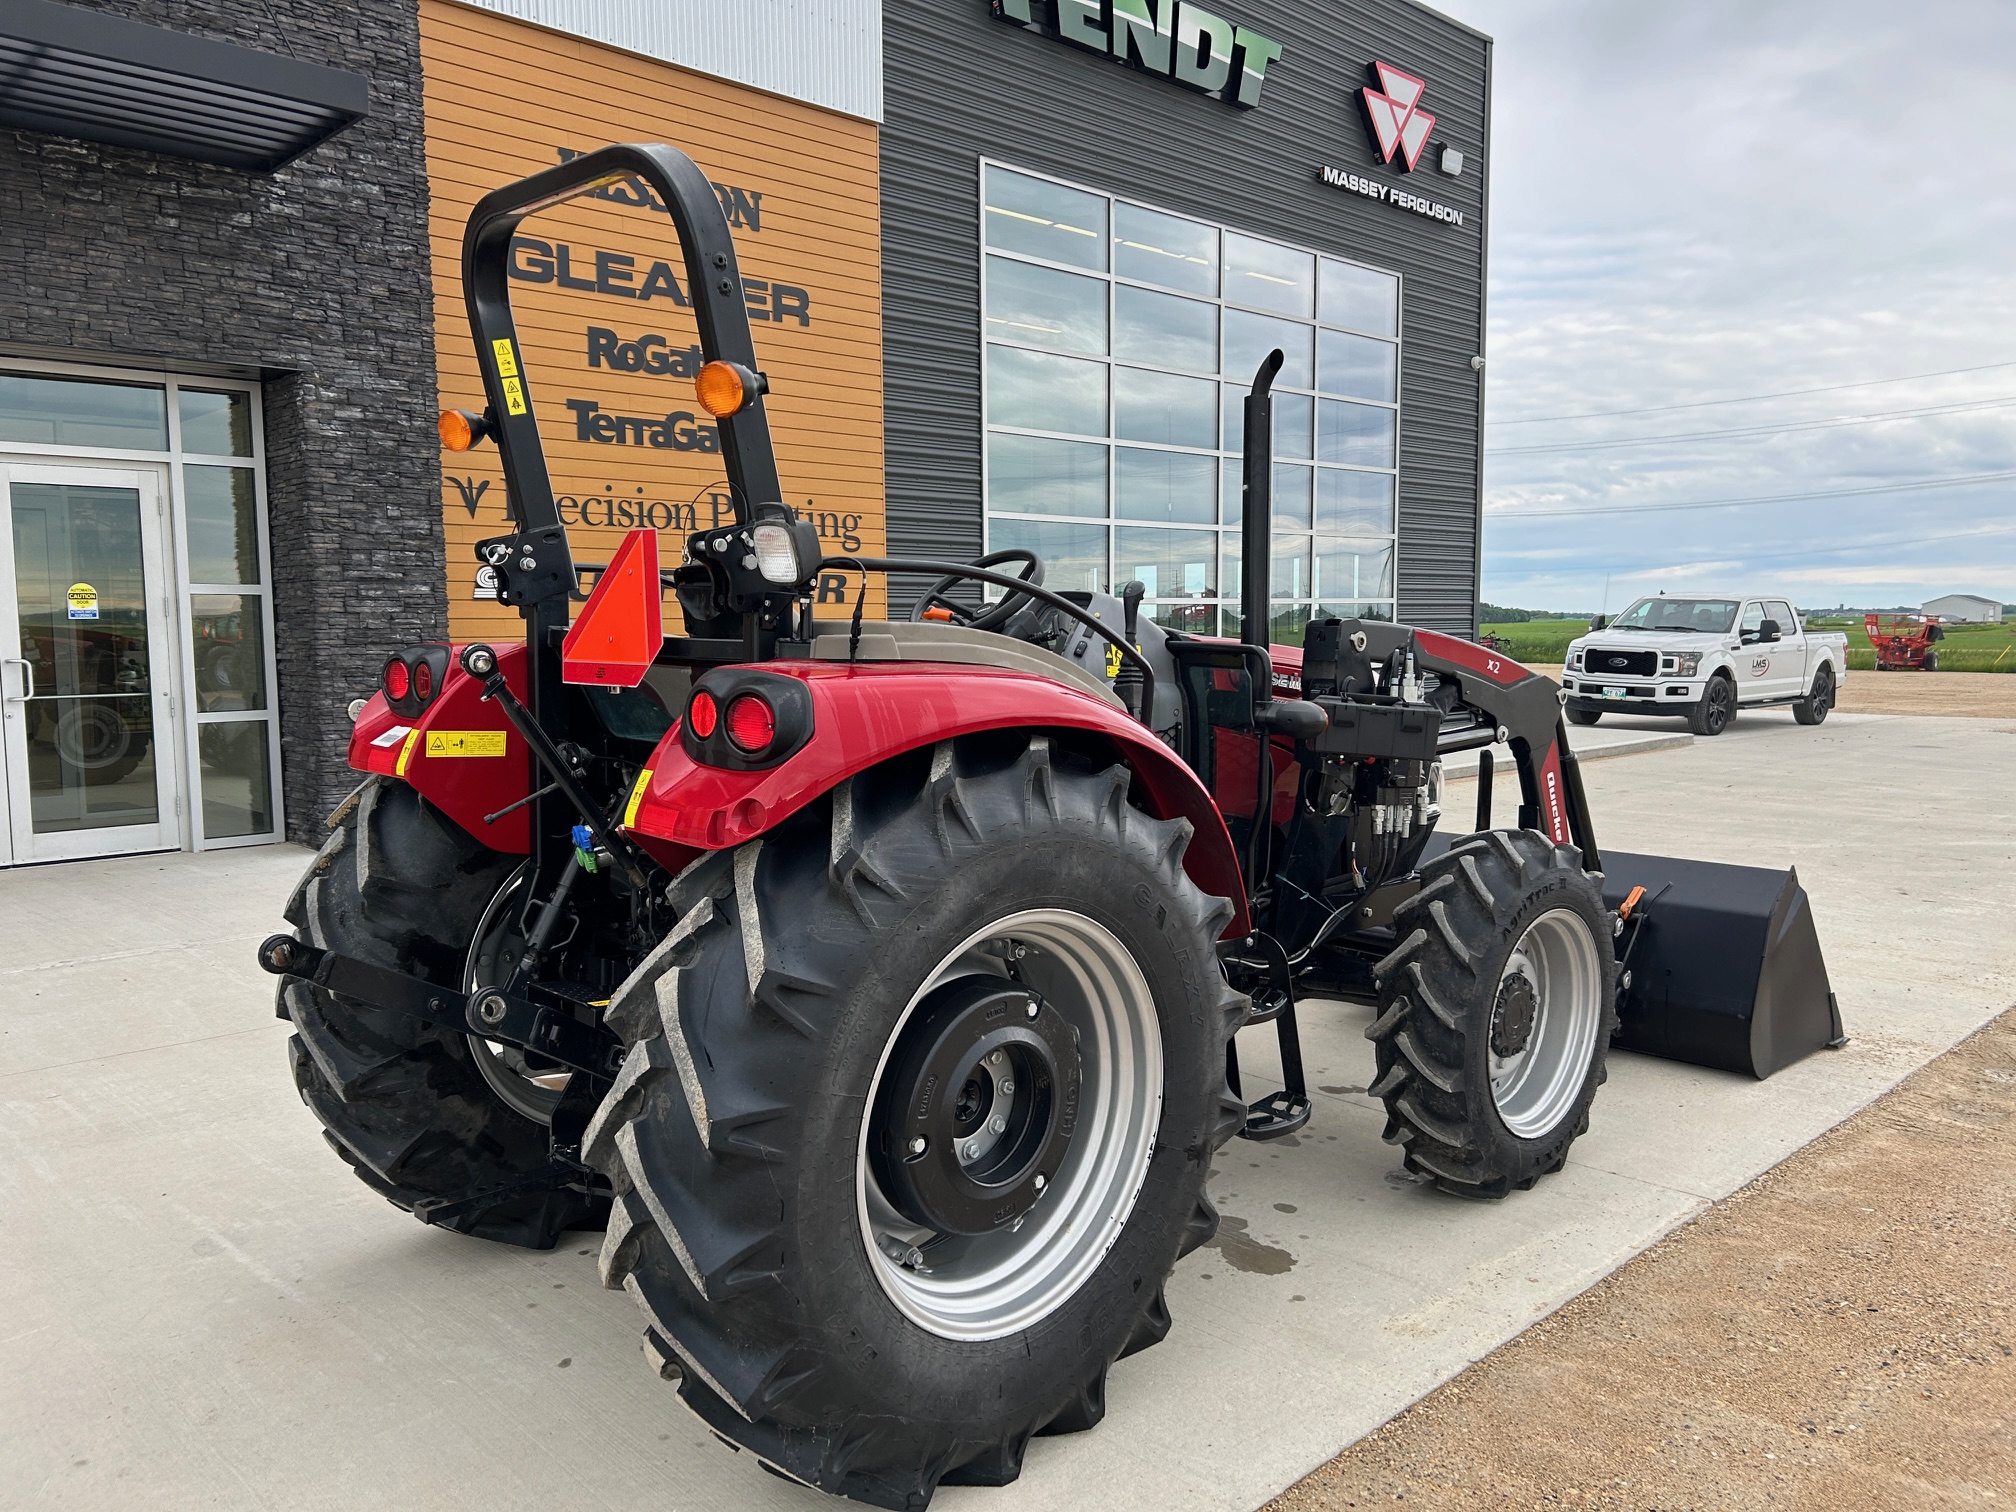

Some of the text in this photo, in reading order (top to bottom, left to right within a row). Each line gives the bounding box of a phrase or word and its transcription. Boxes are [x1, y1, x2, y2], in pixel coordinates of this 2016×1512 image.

[1323, 166, 1463, 225] MASSEY FERGUSON
[508, 236, 810, 327] GLEAER
[587, 326, 704, 379] RoGat
[566, 398, 722, 453] TerraGa
[501, 478, 699, 531] ecision
[1486, 659, 1500, 674] X2
[1752, 659, 1767, 668] LMS
